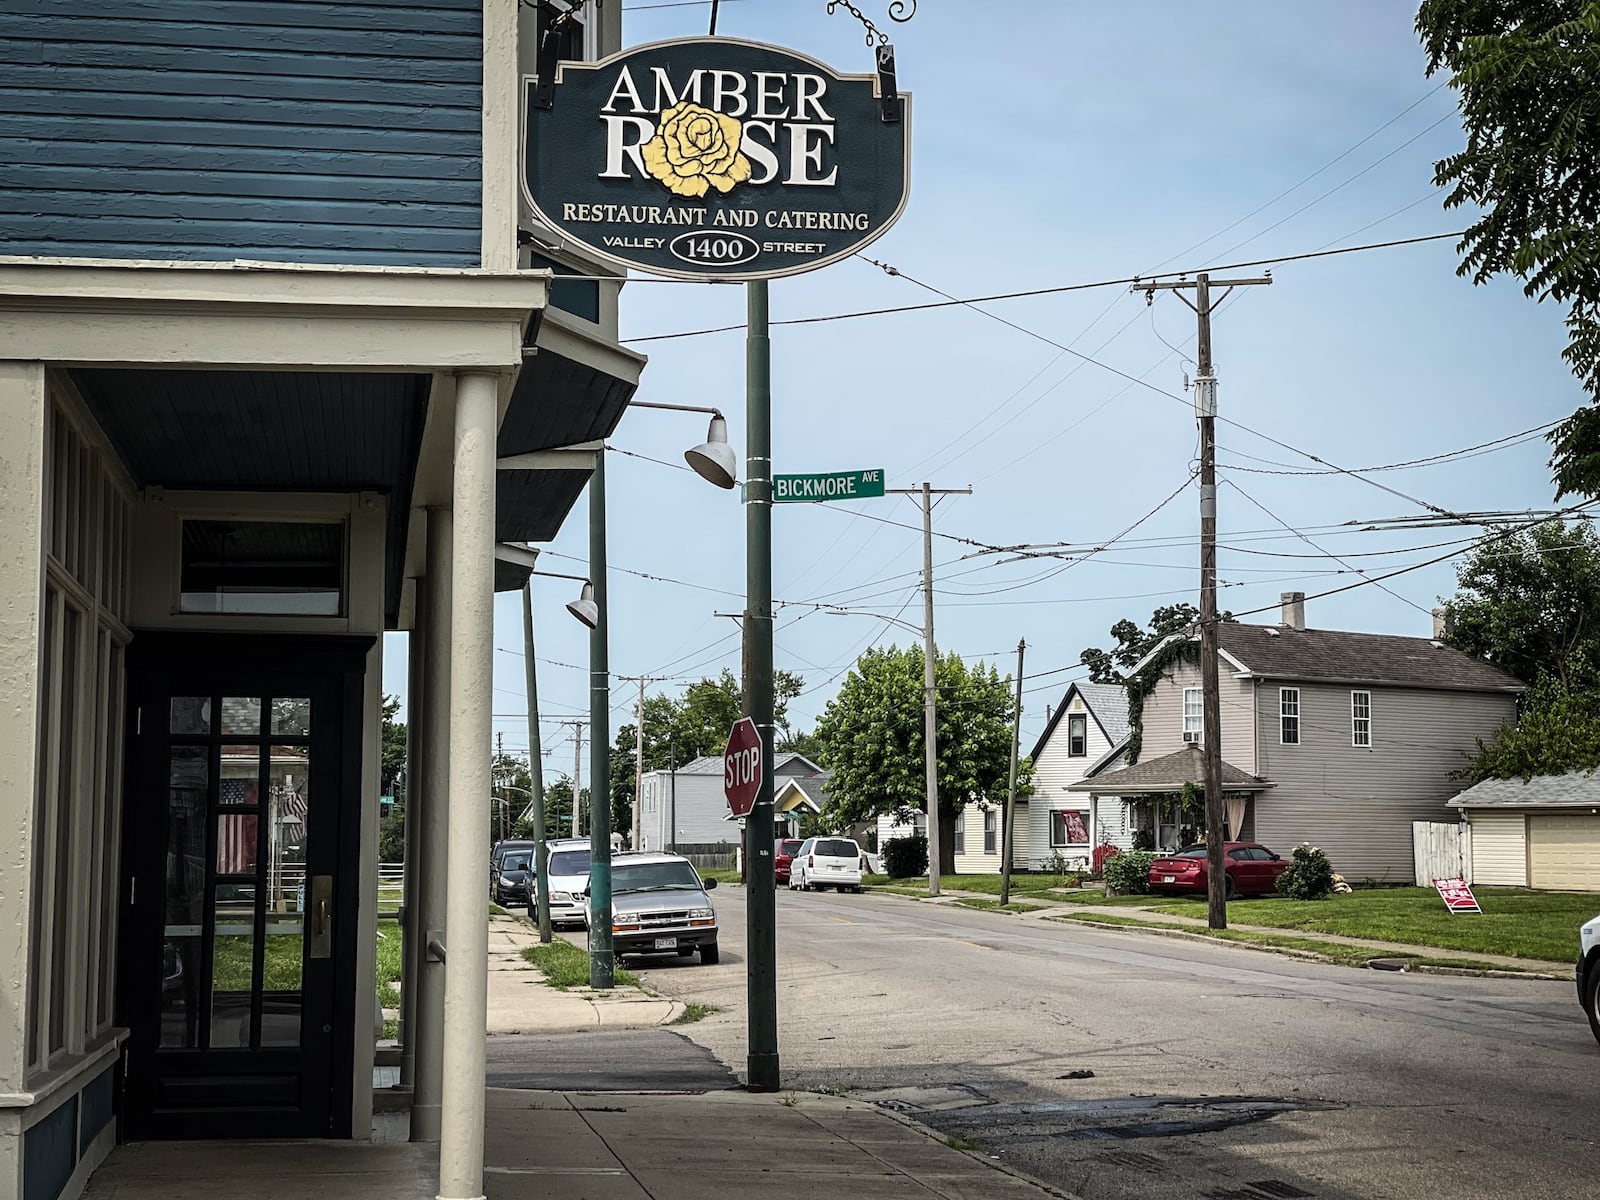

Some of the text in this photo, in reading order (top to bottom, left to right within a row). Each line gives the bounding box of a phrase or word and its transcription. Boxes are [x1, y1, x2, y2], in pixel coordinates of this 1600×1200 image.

[601, 64, 836, 121] AMBER
[597, 114, 839, 186] RSE
[563, 202, 869, 231] RESTAURANT AND CATERING
[602, 236, 827, 259] VALLEY 1400 STREET
[777, 470, 879, 497] BICKMORE AVE
[725, 746, 760, 789] STOP
